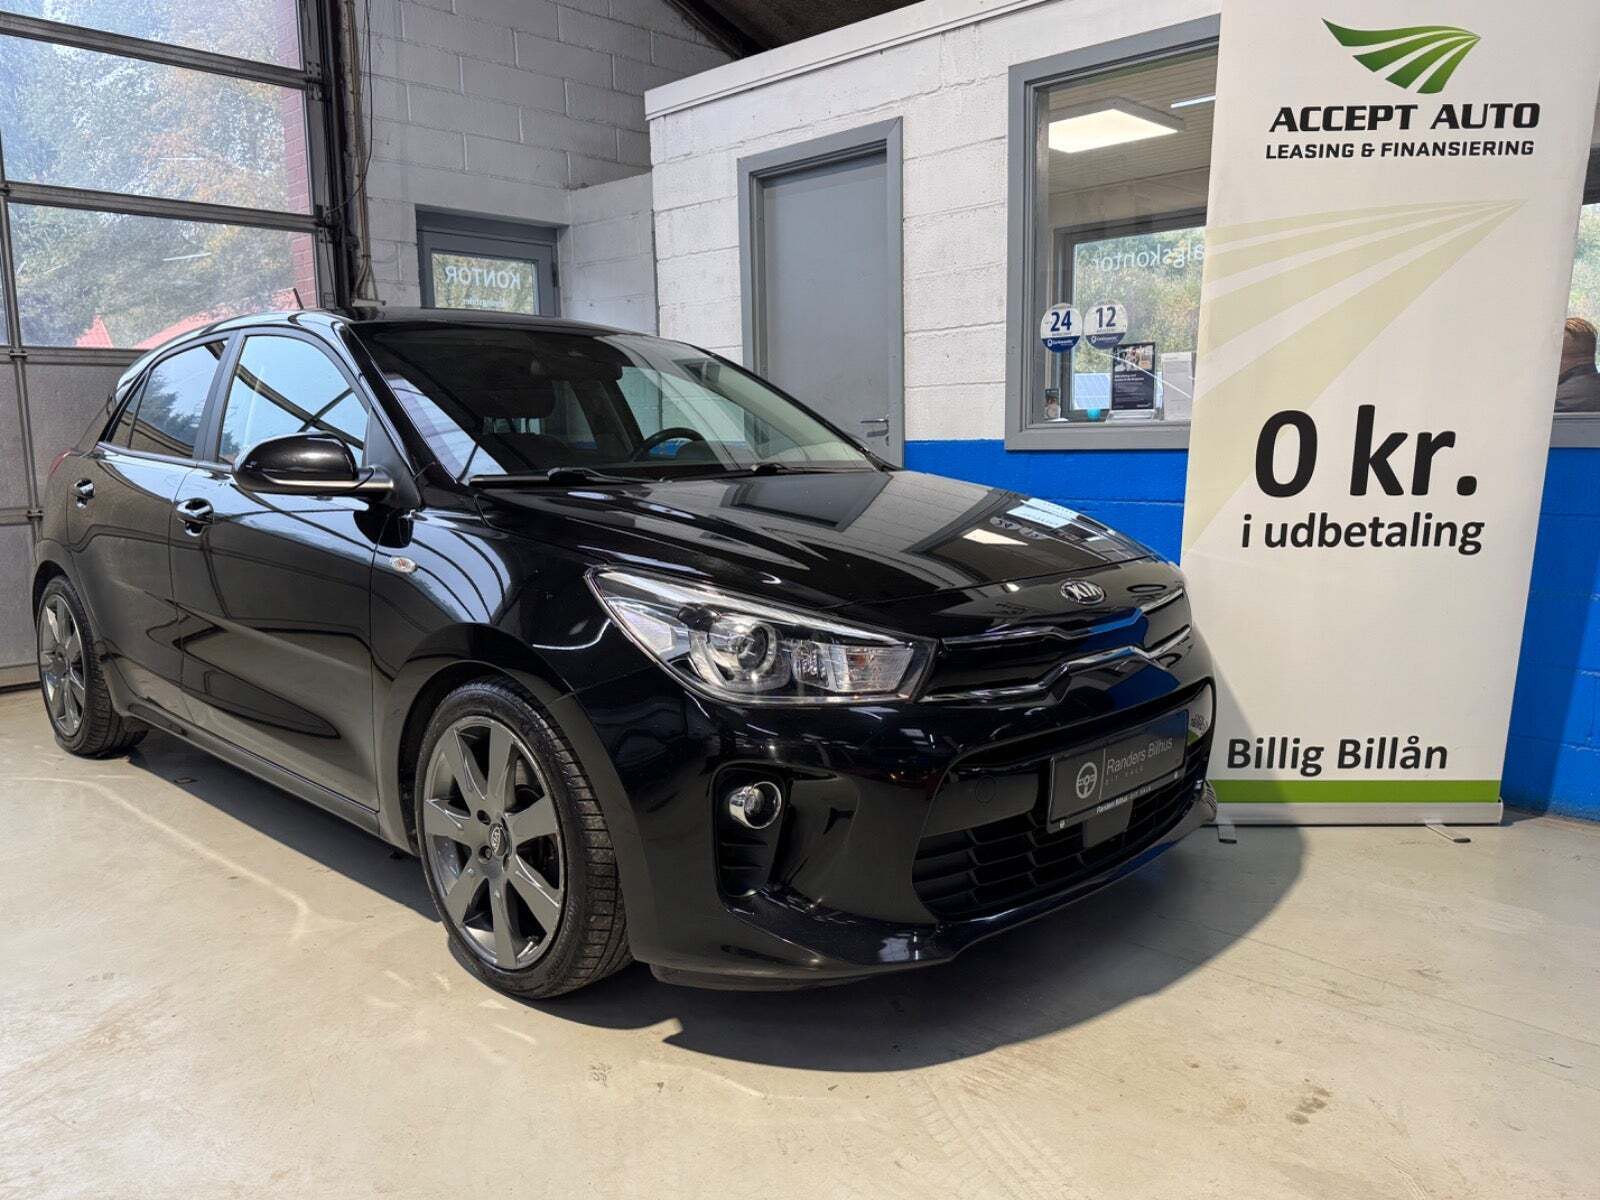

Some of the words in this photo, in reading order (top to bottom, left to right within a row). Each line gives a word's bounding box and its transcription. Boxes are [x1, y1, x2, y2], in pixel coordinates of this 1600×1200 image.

[1269, 104, 1418, 132] ACCEPT
[1430, 102, 1541, 130] AUTO
[1265, 143, 1354, 159] LEASING
[1361, 143, 1376, 158] &
[1380, 140, 1535, 157] FINANSIERING
[1050, 309, 1072, 332] 24
[1095, 306, 1116, 328] 12
[1255, 409, 1318, 498] 0
[1349, 404, 1478, 497] kr.
[1241, 513, 1252, 548] i
[1264, 511, 1485, 556] udbetaling
[1106, 750, 1146, 775] Randers
[1226, 736, 1325, 777] Billig
[1337, 735, 1448, 770] Billån
